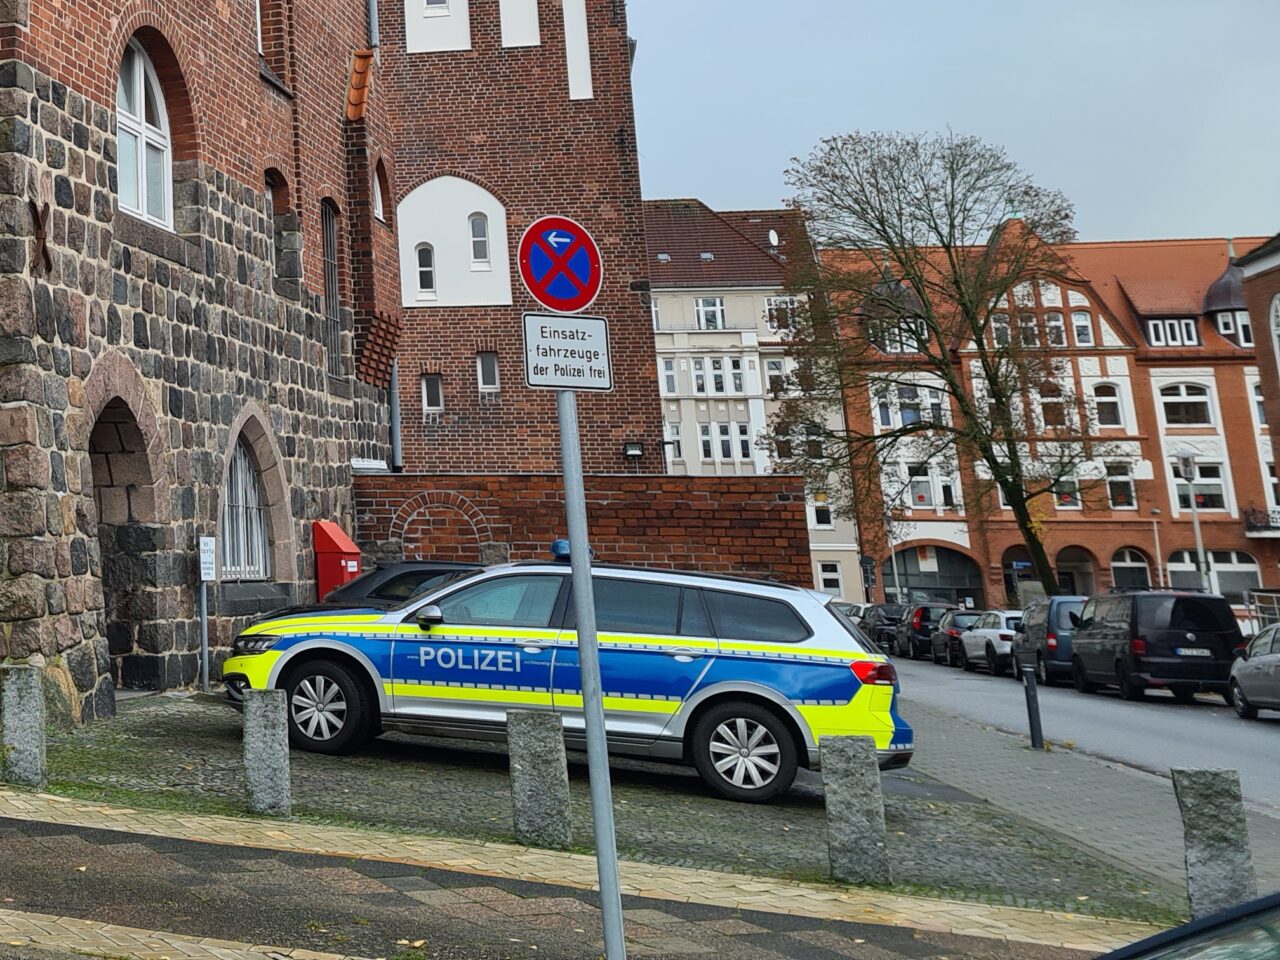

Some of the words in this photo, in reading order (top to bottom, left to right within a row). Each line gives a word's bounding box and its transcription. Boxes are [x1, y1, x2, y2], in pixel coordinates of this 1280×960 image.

[540, 325, 593, 341] Einsatz-
[536, 344, 600, 363] fahrzeuge
[533, 363, 549, 376] der
[554, 363, 585, 378] Polizei
[589, 365, 606, 379] frei
[419, 646, 521, 673] POLIZEI
